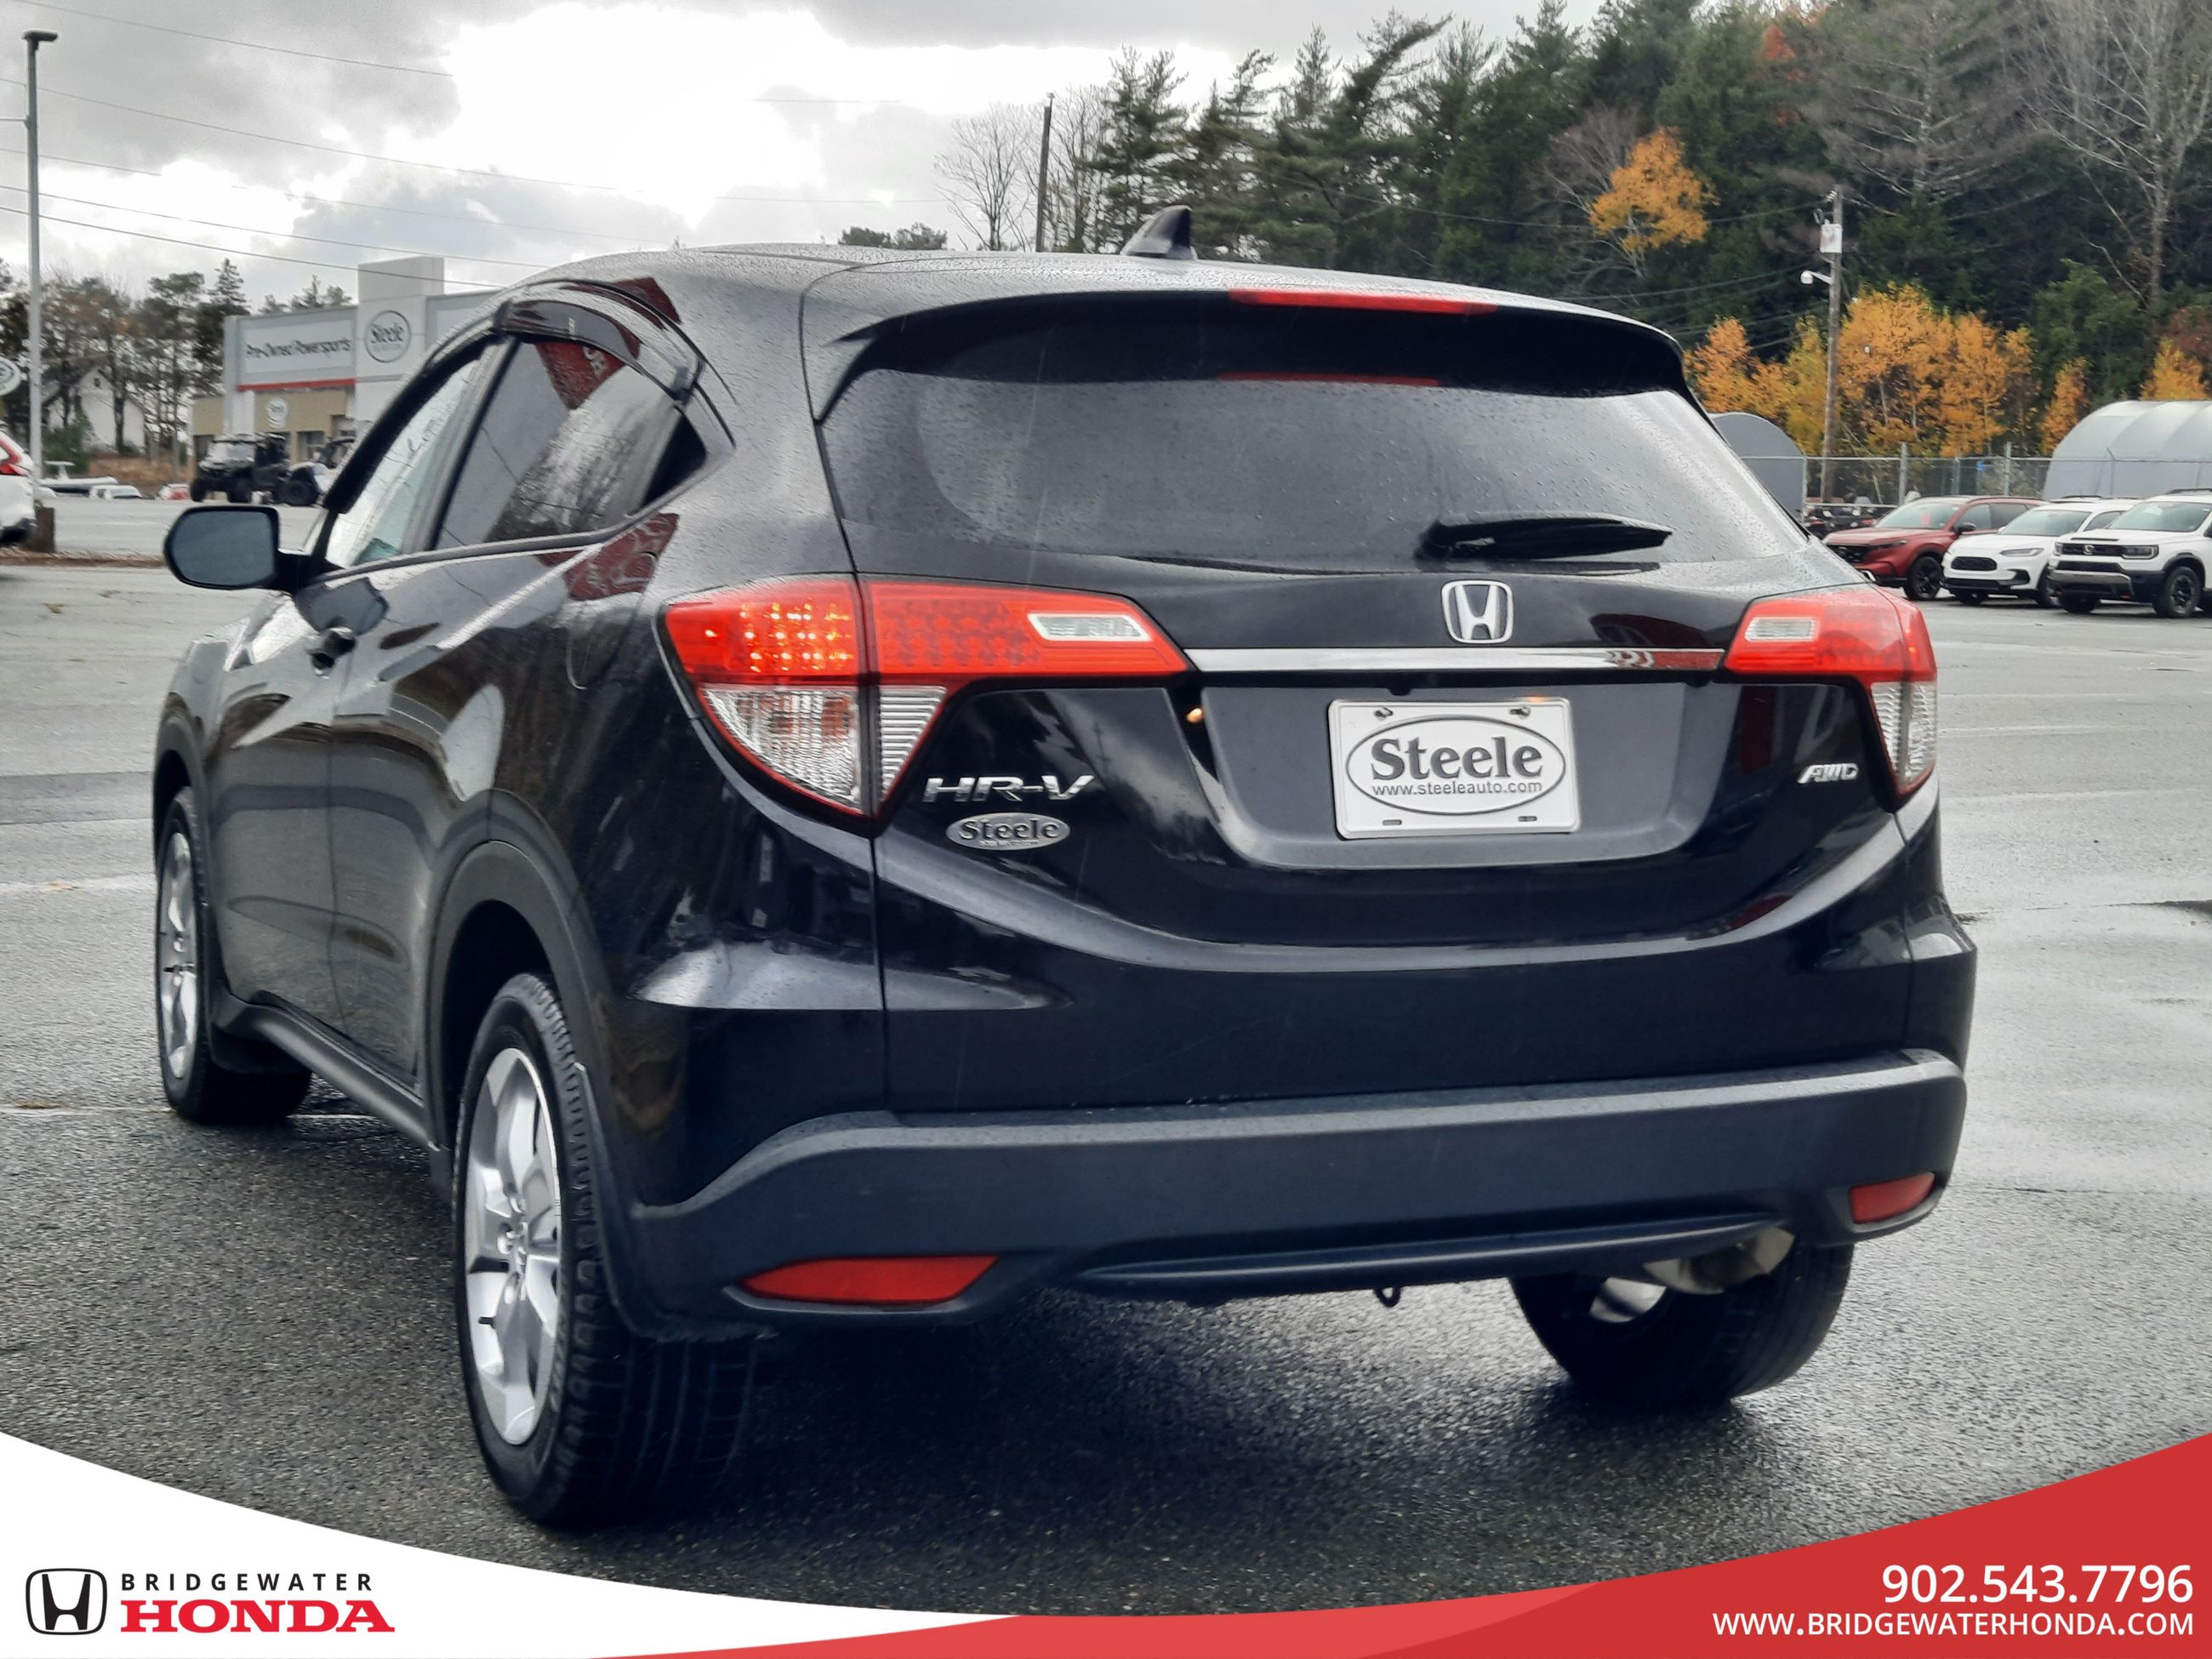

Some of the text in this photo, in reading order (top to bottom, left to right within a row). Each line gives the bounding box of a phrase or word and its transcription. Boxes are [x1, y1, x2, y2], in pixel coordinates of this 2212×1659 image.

[1371, 736, 1542, 780] Steele
[1797, 762, 1859, 784] AWD
[921, 775, 1094, 802] HR-V
[1371, 780, 1542, 795] www.steeleauto.com
[958, 818, 1061, 840] Steele
